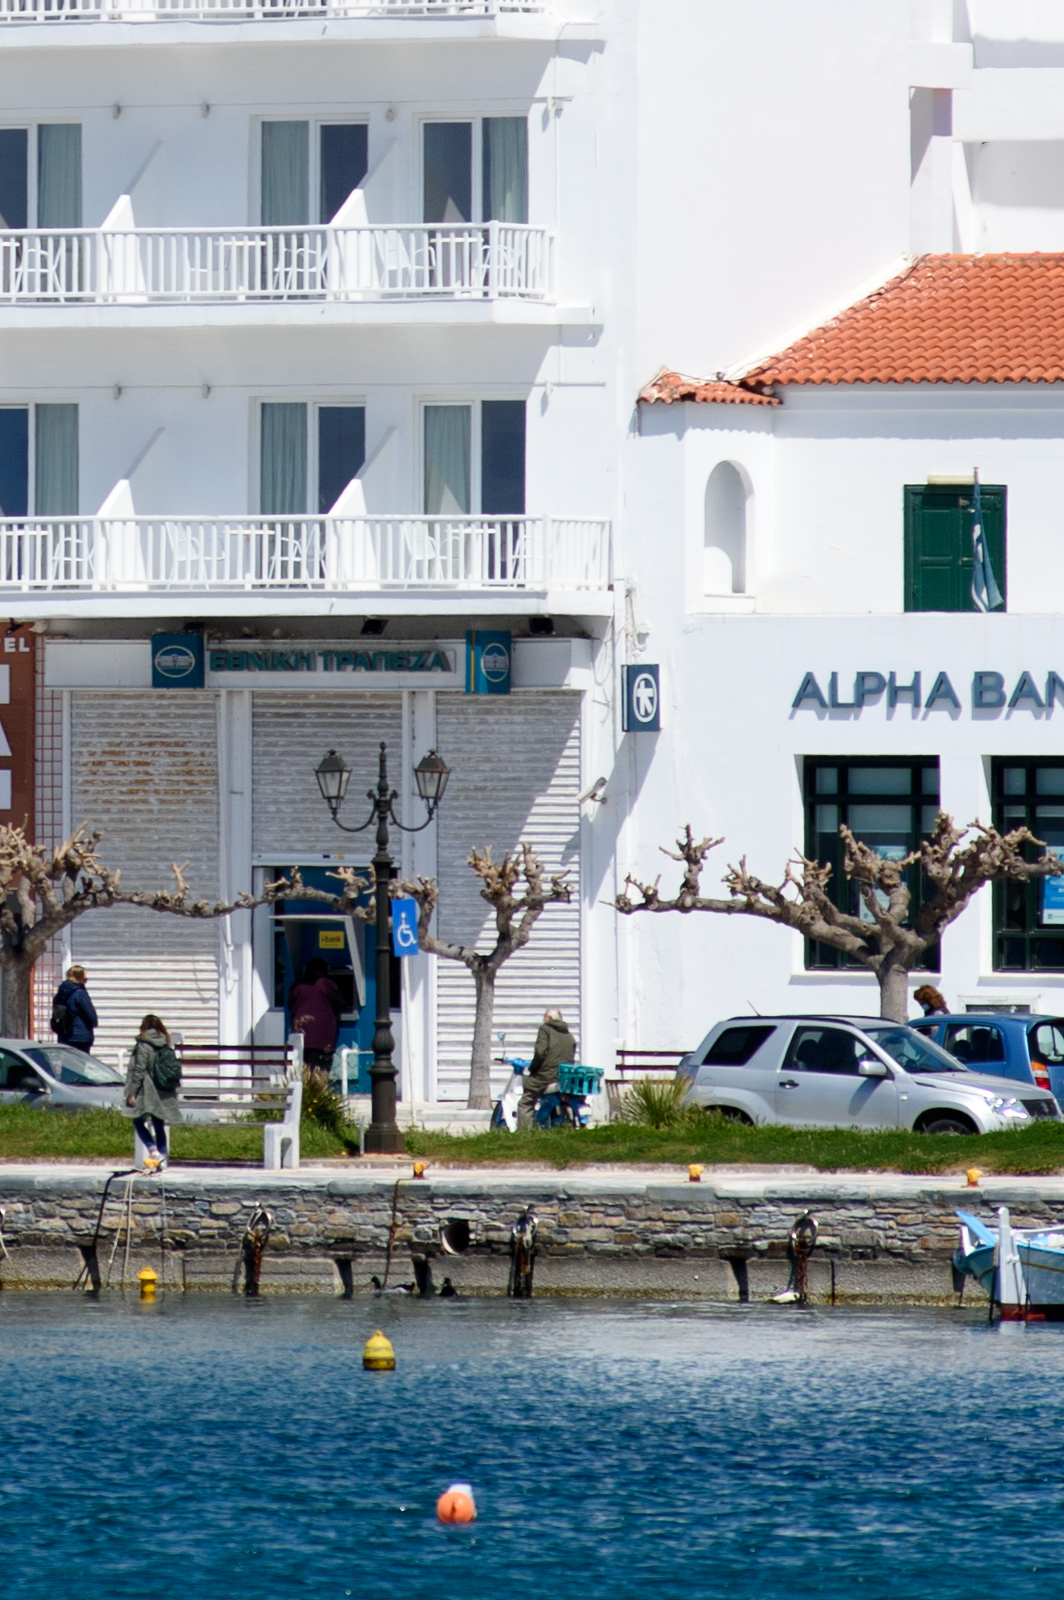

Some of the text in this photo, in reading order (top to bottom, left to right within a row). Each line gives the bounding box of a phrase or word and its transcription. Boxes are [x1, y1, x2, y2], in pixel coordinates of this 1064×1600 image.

[209, 651, 452, 672] ΕΘΝΙΚΗ ΤΡΑΠΕΖΑ
[791, 671, 962, 708] ALPHA
